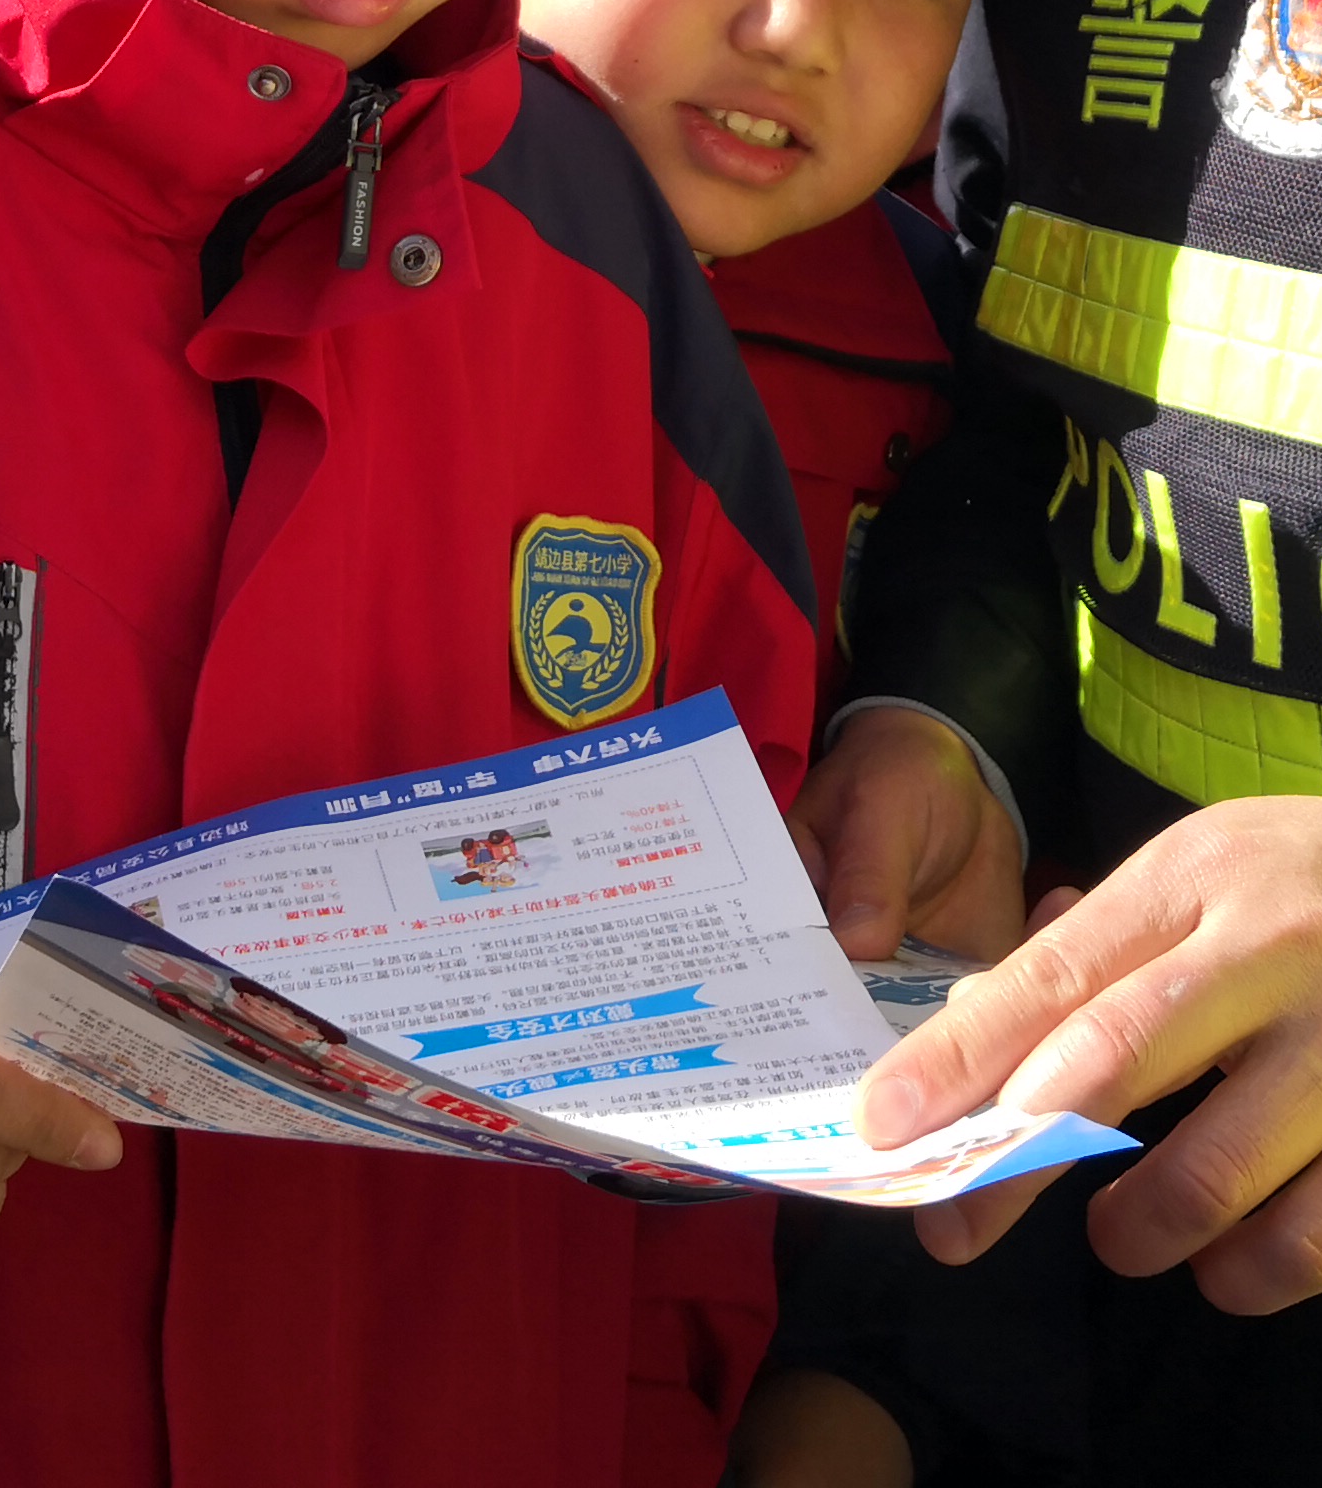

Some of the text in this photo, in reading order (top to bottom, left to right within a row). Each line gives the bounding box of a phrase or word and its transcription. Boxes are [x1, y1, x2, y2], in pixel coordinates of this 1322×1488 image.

[351, 180, 368, 247] FASHION
[535, 547, 633, 576] 靖边县第七小学
[531, 725, 663, 774] 头等大事
[575, 827, 695, 860] 可使受伤者的比例
[484, 998, 634, 1044] 戴对才安全
